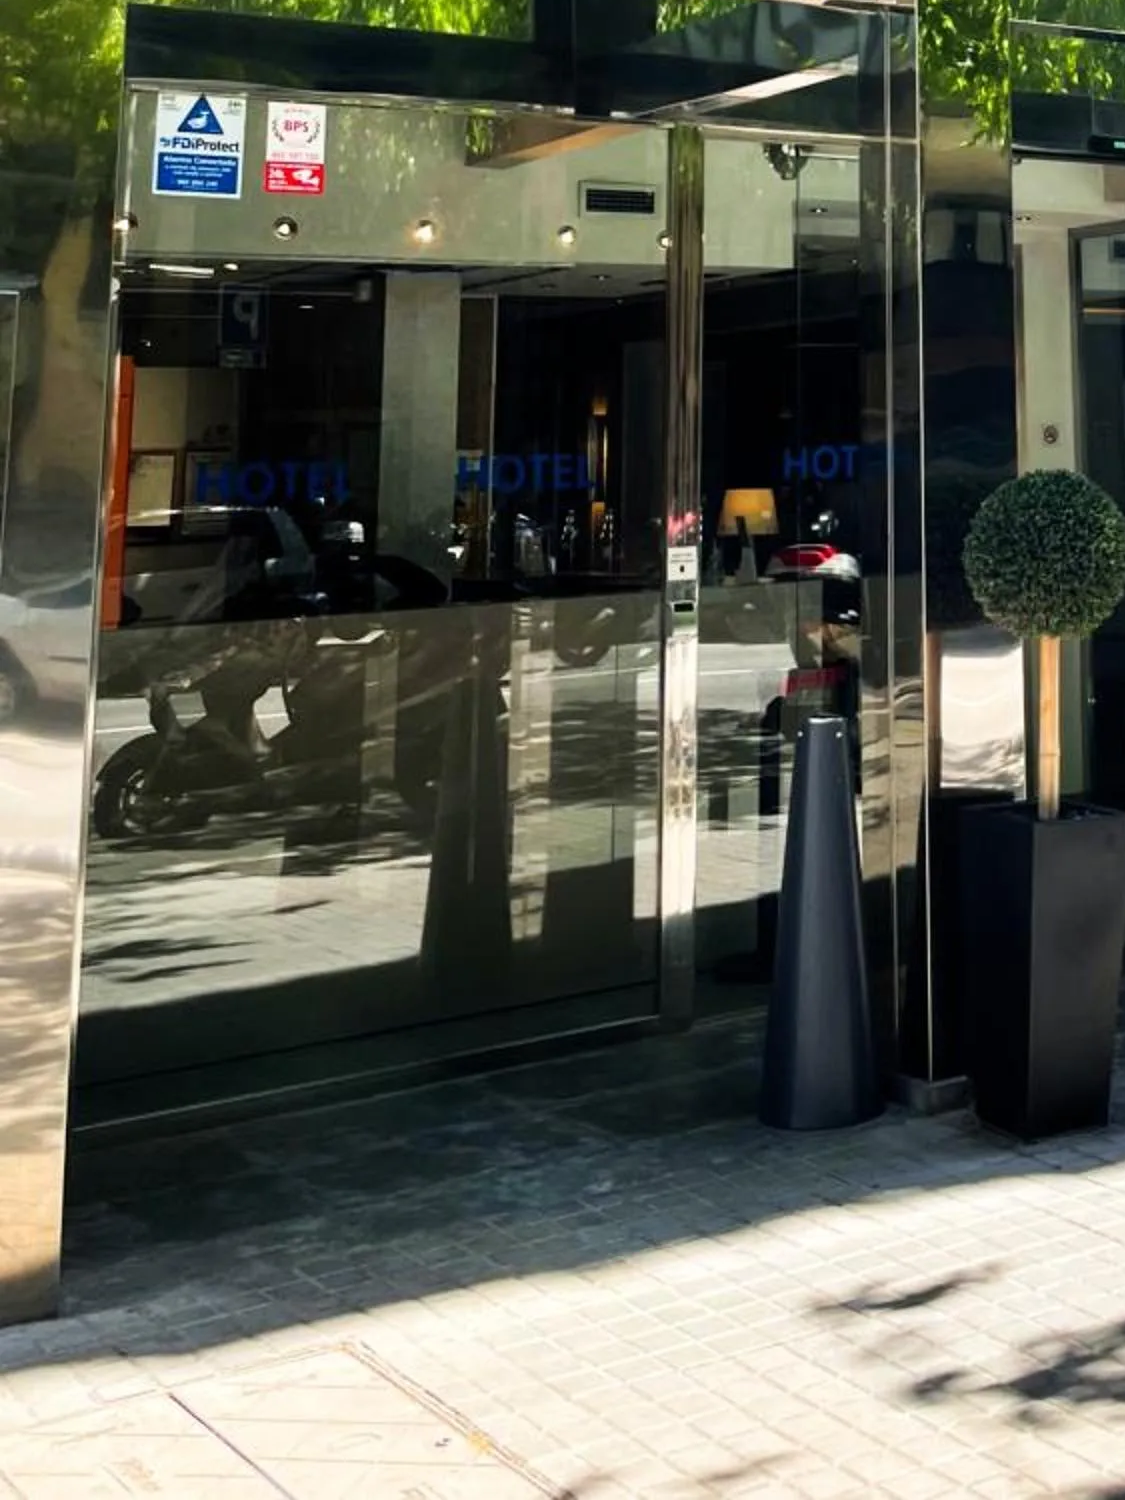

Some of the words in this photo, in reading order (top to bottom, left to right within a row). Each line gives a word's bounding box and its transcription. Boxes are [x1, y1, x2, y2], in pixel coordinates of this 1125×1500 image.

[197, 458, 352, 504] HOTEL
[457, 451, 597, 493] HOTEL
[783, 443, 885, 481] HOT
